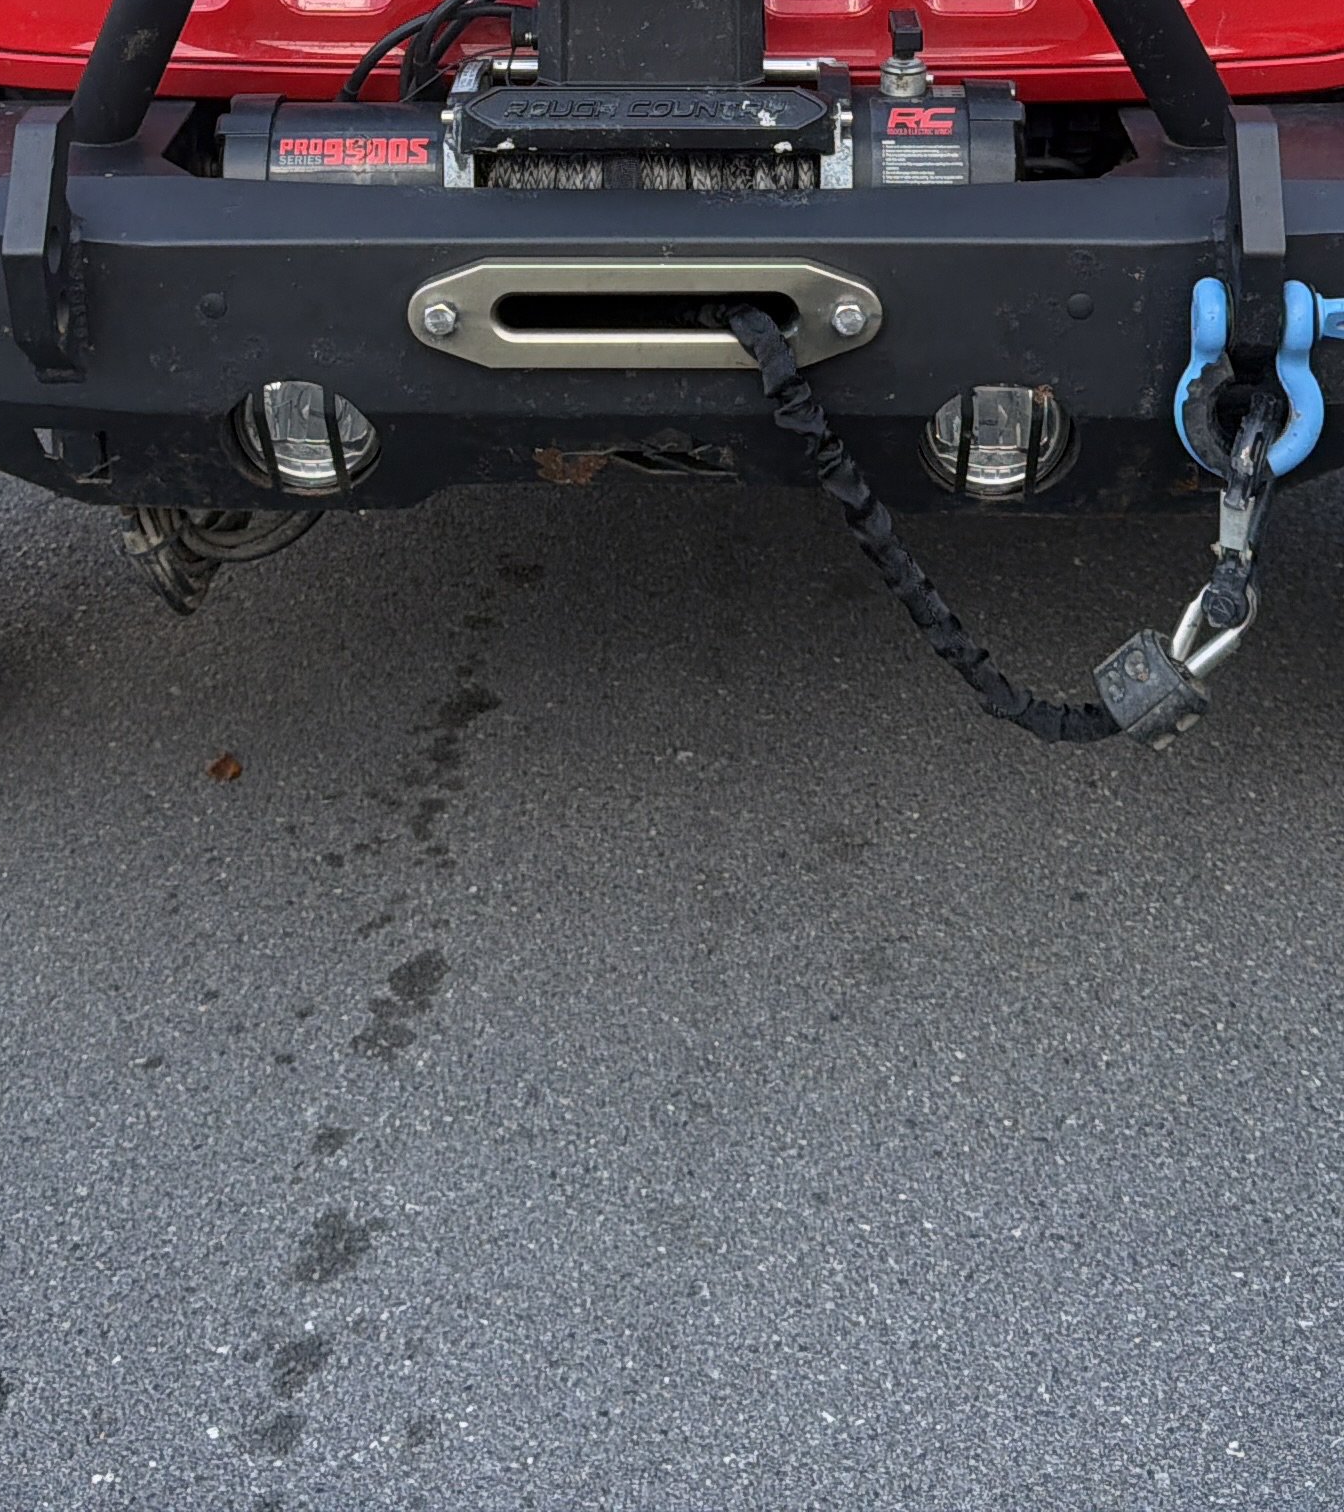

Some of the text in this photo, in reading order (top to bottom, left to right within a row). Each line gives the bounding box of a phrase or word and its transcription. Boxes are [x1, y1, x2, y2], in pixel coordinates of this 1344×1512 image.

[504, 99, 787, 121] ROUGH COUNTRY
[887, 107, 956, 129] RC
[279, 139, 324, 155] PRO
[278, 156, 322, 166] SERIES
